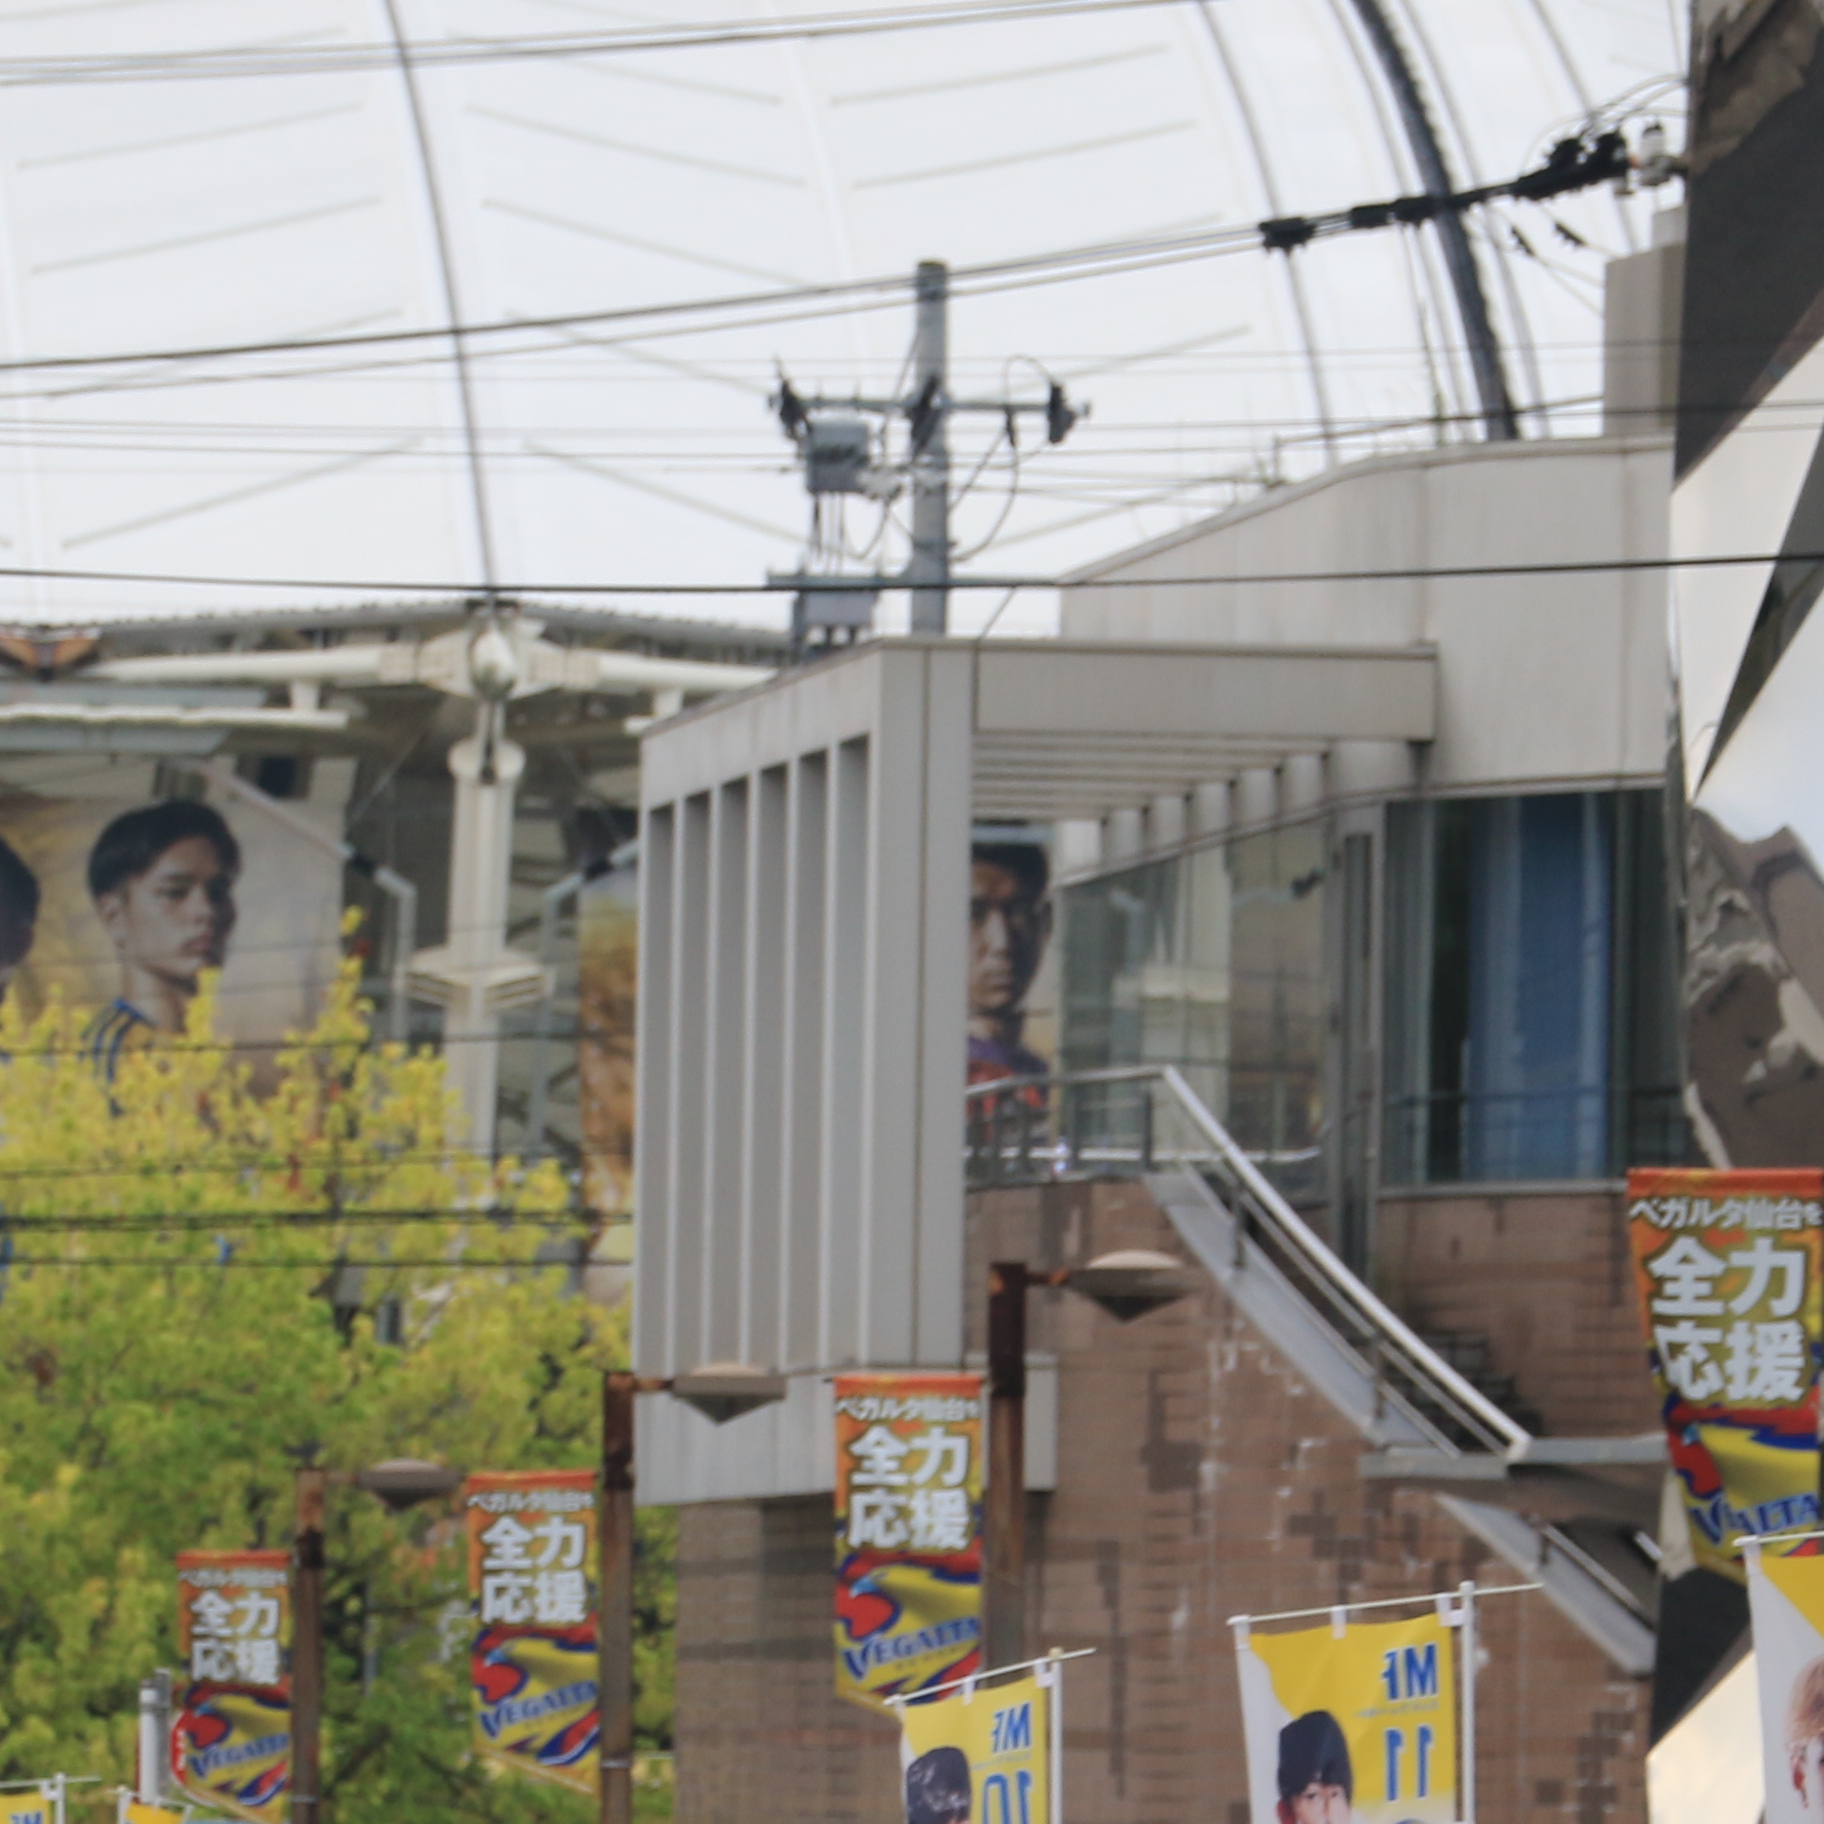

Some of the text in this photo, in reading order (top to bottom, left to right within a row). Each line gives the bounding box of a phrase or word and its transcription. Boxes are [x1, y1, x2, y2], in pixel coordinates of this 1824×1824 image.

[1629, 1197, 1824, 1230] ベガルタ仙台を
[1648, 1234, 1808, 1319] 全力
[1654, 1321, 1807, 1402] 応援
[849, 1425, 970, 1488] 全力
[481, 1515, 586, 1570] 全力
[848, 1488, 970, 1551] 応援
[190, 1590, 280, 1638] 全力
[480, 1571, 587, 1624] 応援
[190, 1639, 280, 1685] 応援
